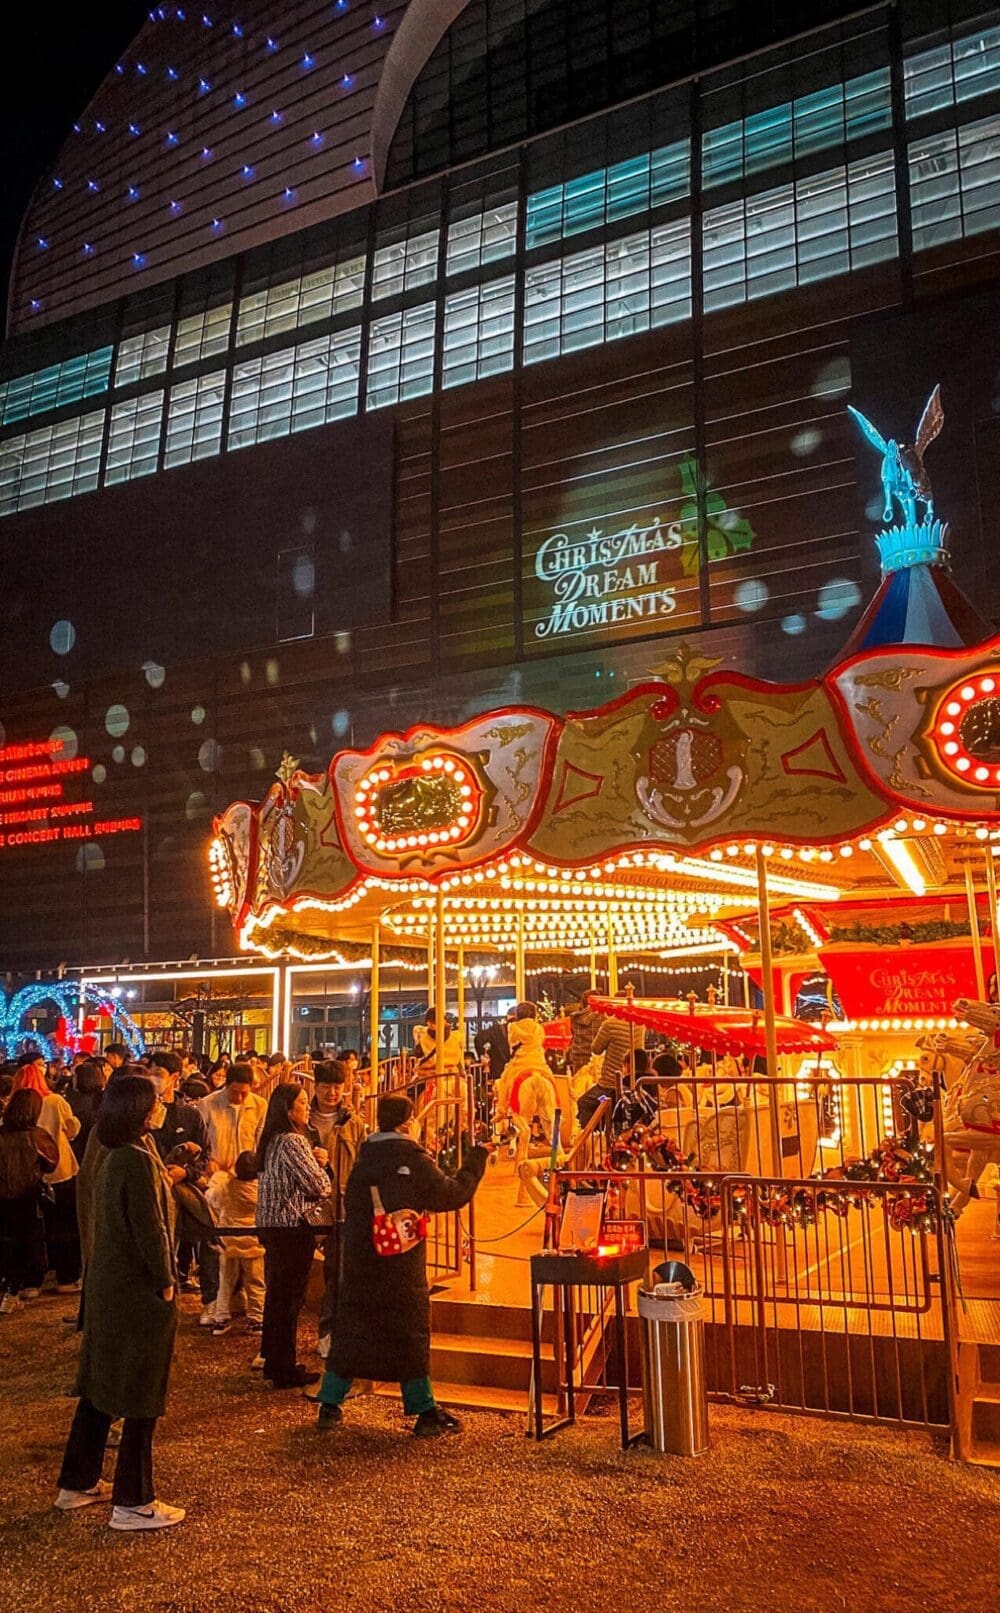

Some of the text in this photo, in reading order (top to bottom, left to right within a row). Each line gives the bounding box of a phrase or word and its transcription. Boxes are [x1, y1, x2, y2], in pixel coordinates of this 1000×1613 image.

[535, 516, 682, 582] CHRISTMAS
[554, 560, 660, 604] DREAM
[535, 586, 676, 637] MOMENTS
[7, 828, 60, 846] CONCERT
[63, 825, 92, 839] HALL
